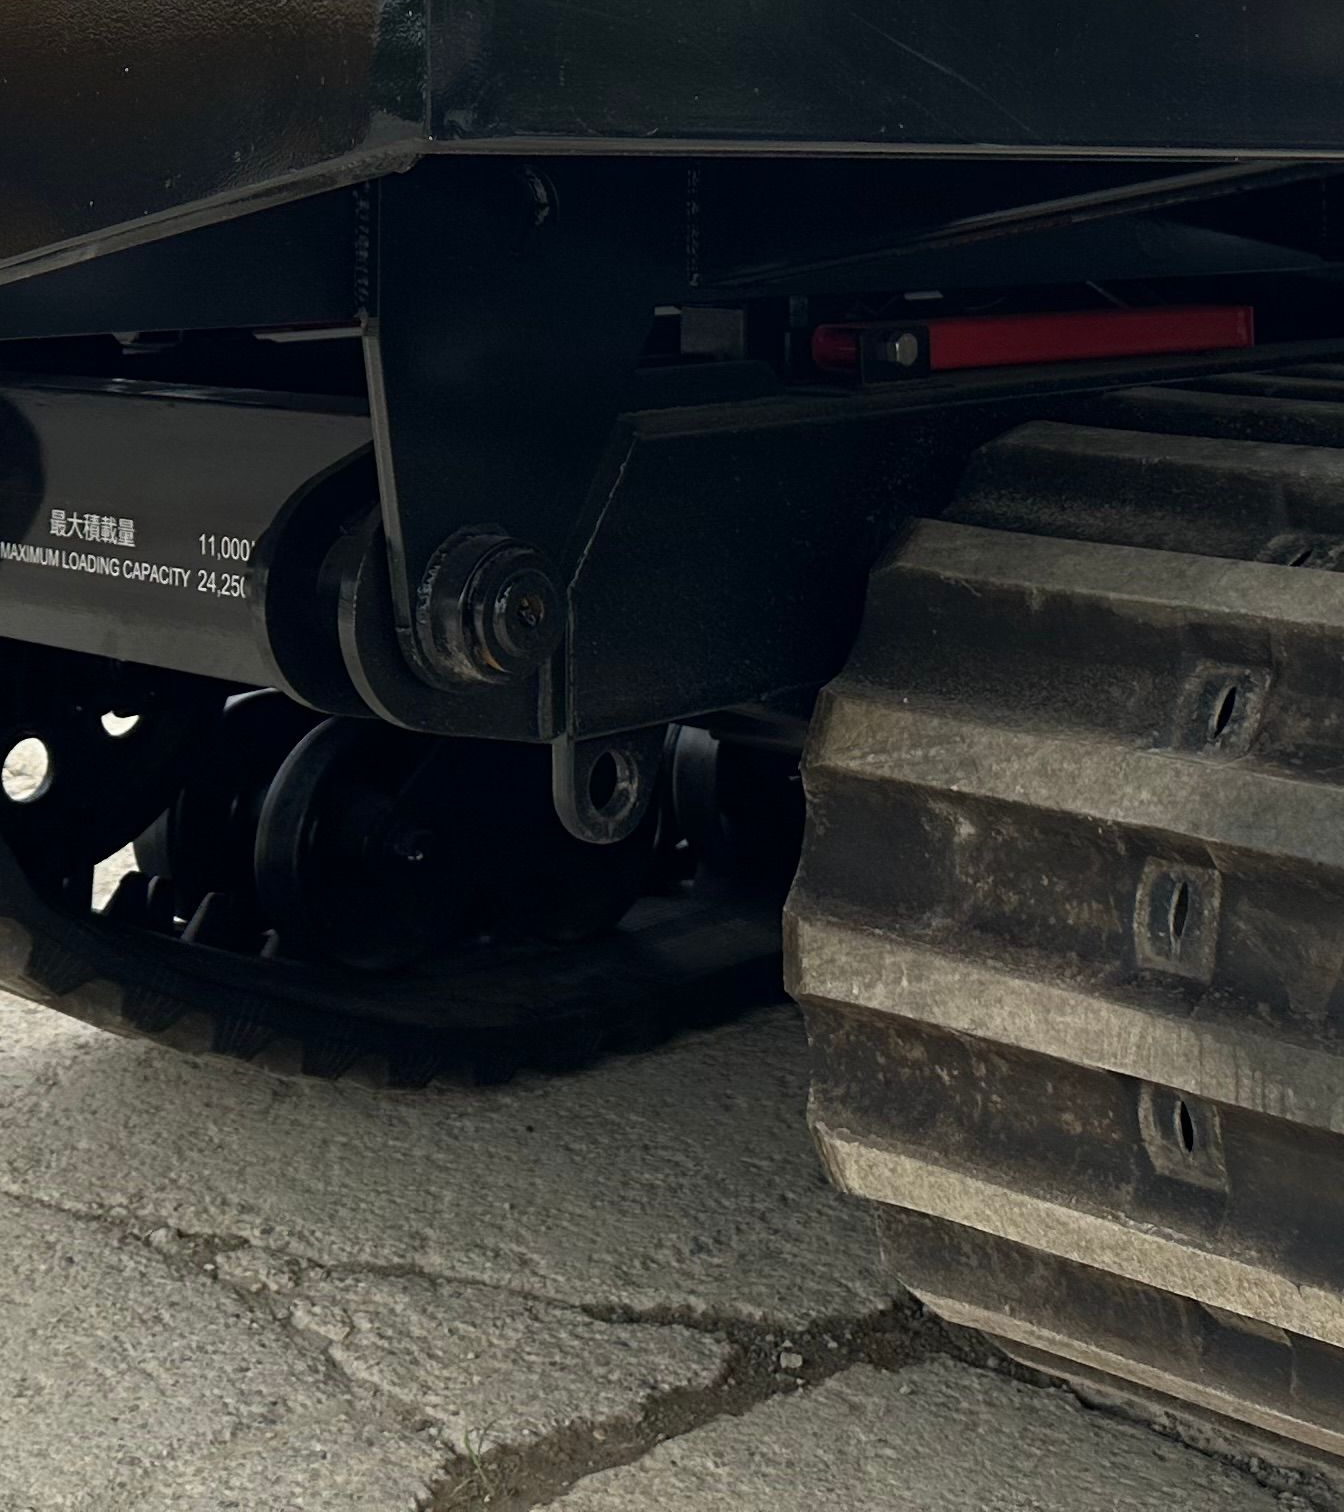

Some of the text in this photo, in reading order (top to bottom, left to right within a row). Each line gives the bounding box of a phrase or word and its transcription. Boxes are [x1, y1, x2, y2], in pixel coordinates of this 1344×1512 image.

[49, 509, 256, 562] 最大積載量 11,000
[0, 541, 60, 568] MAXIMUM
[61, 550, 121, 577] LOADING
[122, 560, 192, 588] CAPACITY
